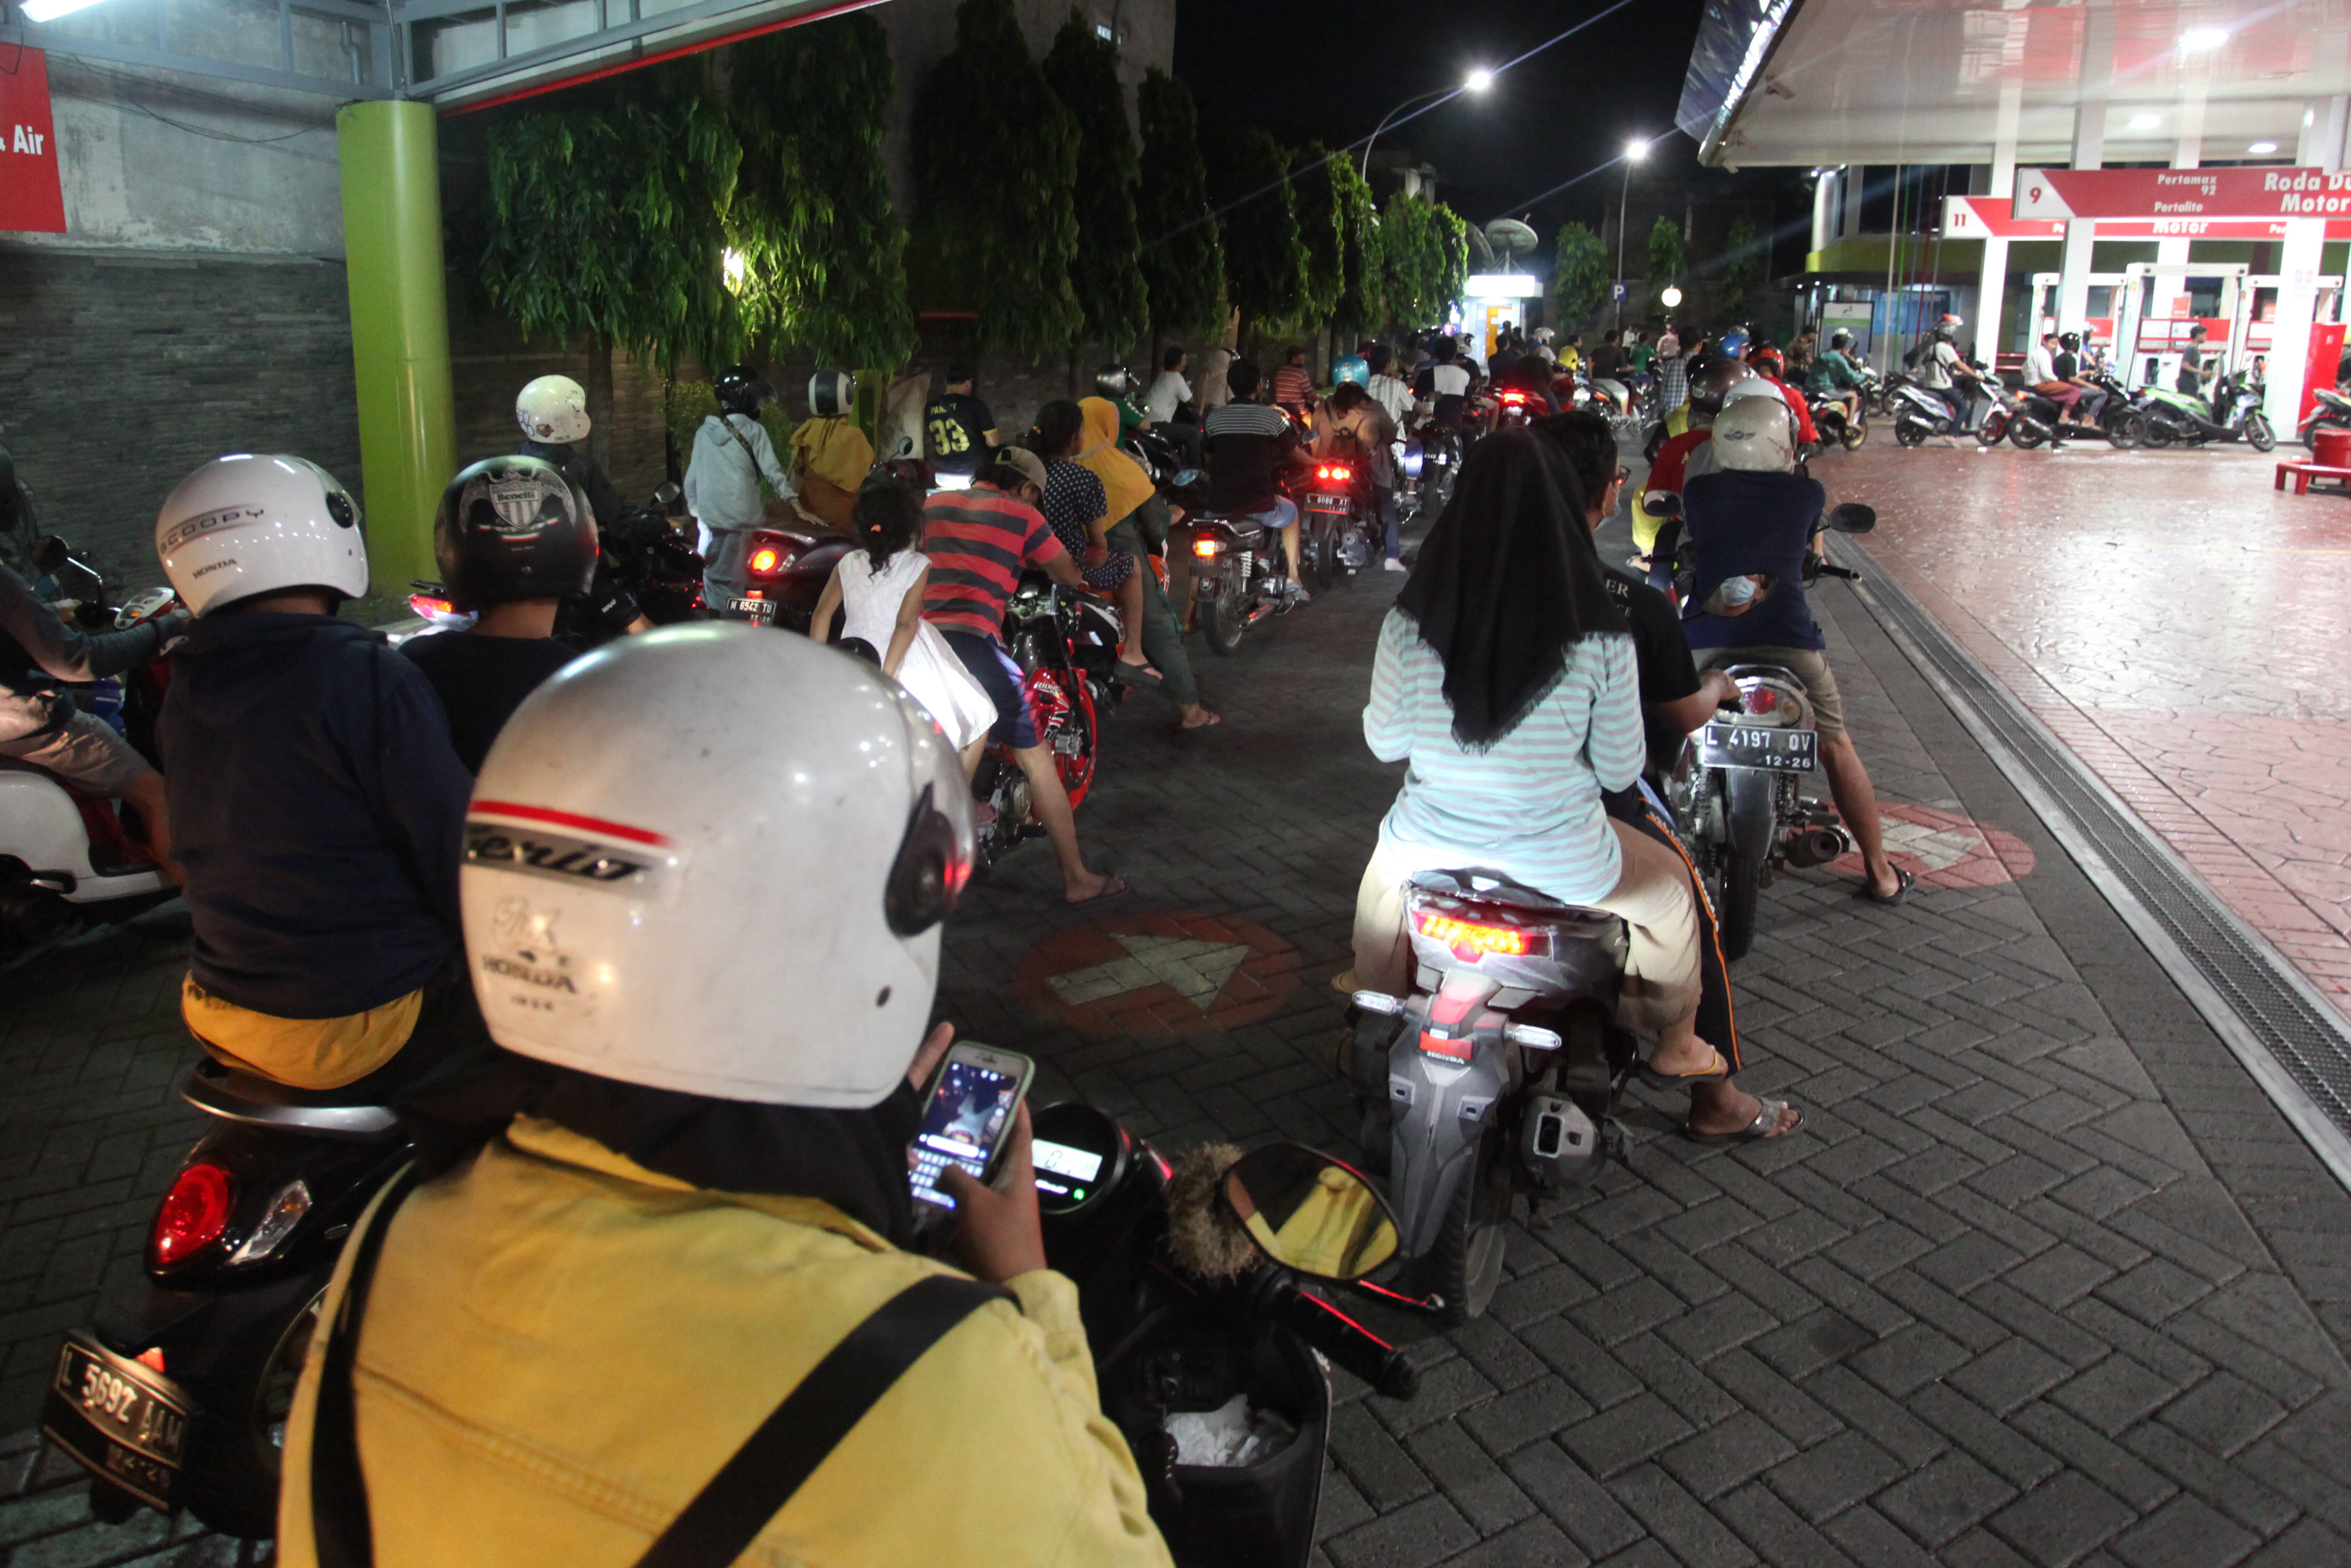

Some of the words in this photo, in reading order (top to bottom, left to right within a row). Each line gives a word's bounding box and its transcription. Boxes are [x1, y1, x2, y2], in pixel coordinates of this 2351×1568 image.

[14, 124, 44, 155] Air
[2158, 174, 2217, 185] Pertamax
[2264, 171, 2321, 191] Roda
[2030, 187, 2042, 204] 9
[2201, 185, 2217, 196] 92
[2154, 200, 2203, 213] Pertalite
[2280, 193, 2350, 212] Motor
[1954, 213, 1967, 227] 11
[2153, 222, 2209, 234] Motor
[1614, 285, 1625, 300] P
[929, 417, 970, 455] 33
[497, 490, 535, 502] Benelli
[192, 558, 237, 579] HONDA
[739, 601, 758, 612] 6542
[762, 603, 773, 614] TU
[1706, 727, 1718, 745] L
[1729, 729, 1771, 749] 4197
[1426, 1050, 1465, 1065] HONDA
[81, 1363, 139, 1423] 5692
